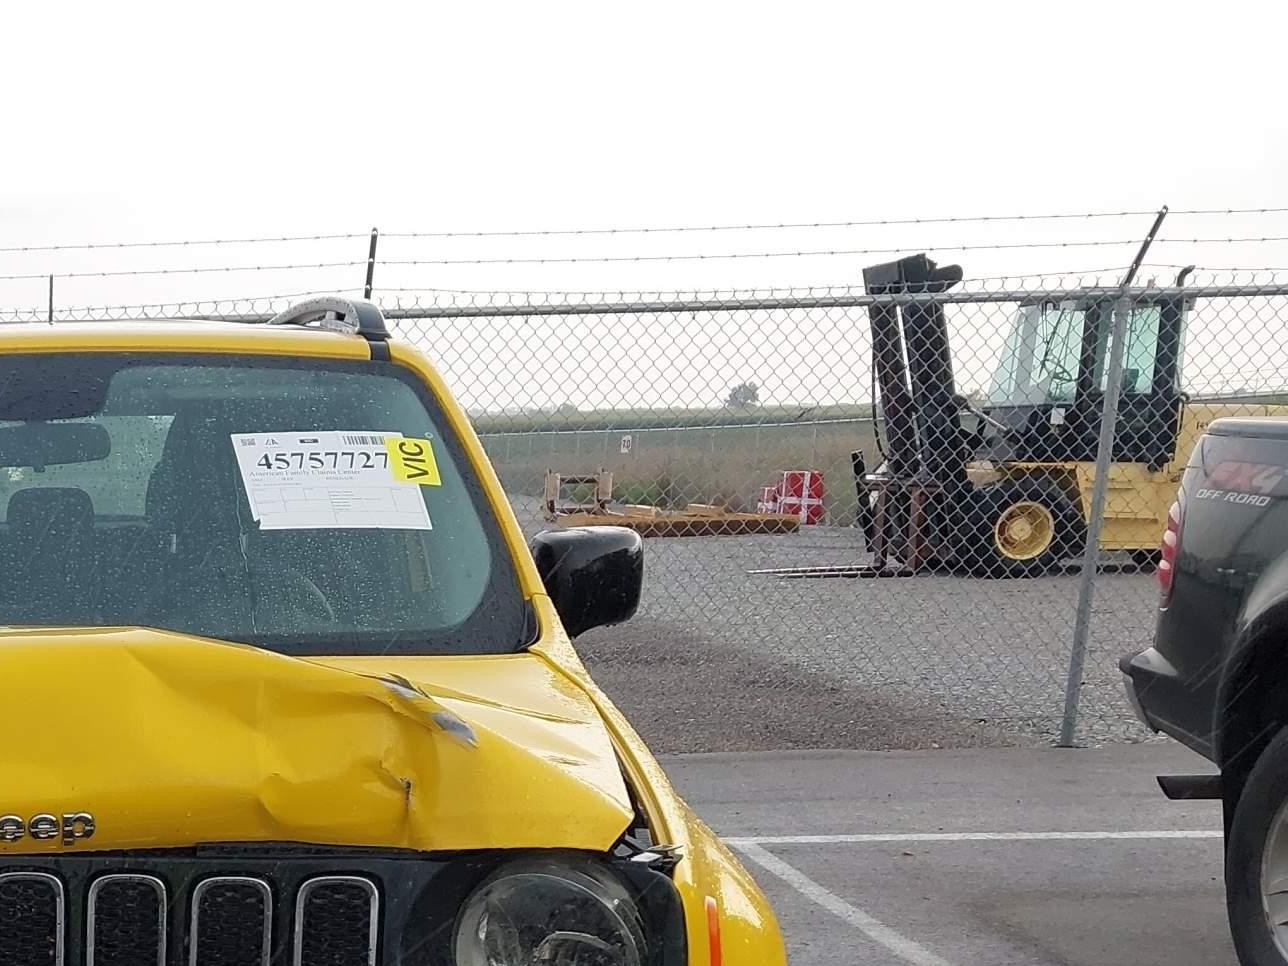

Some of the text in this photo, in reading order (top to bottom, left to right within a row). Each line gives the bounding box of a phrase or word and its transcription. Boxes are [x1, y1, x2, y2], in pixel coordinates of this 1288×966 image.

[257, 452, 388, 469] 45757727
[399, 442, 429, 479] VIC
[1195, 489, 1271, 506] OFF ROAD
